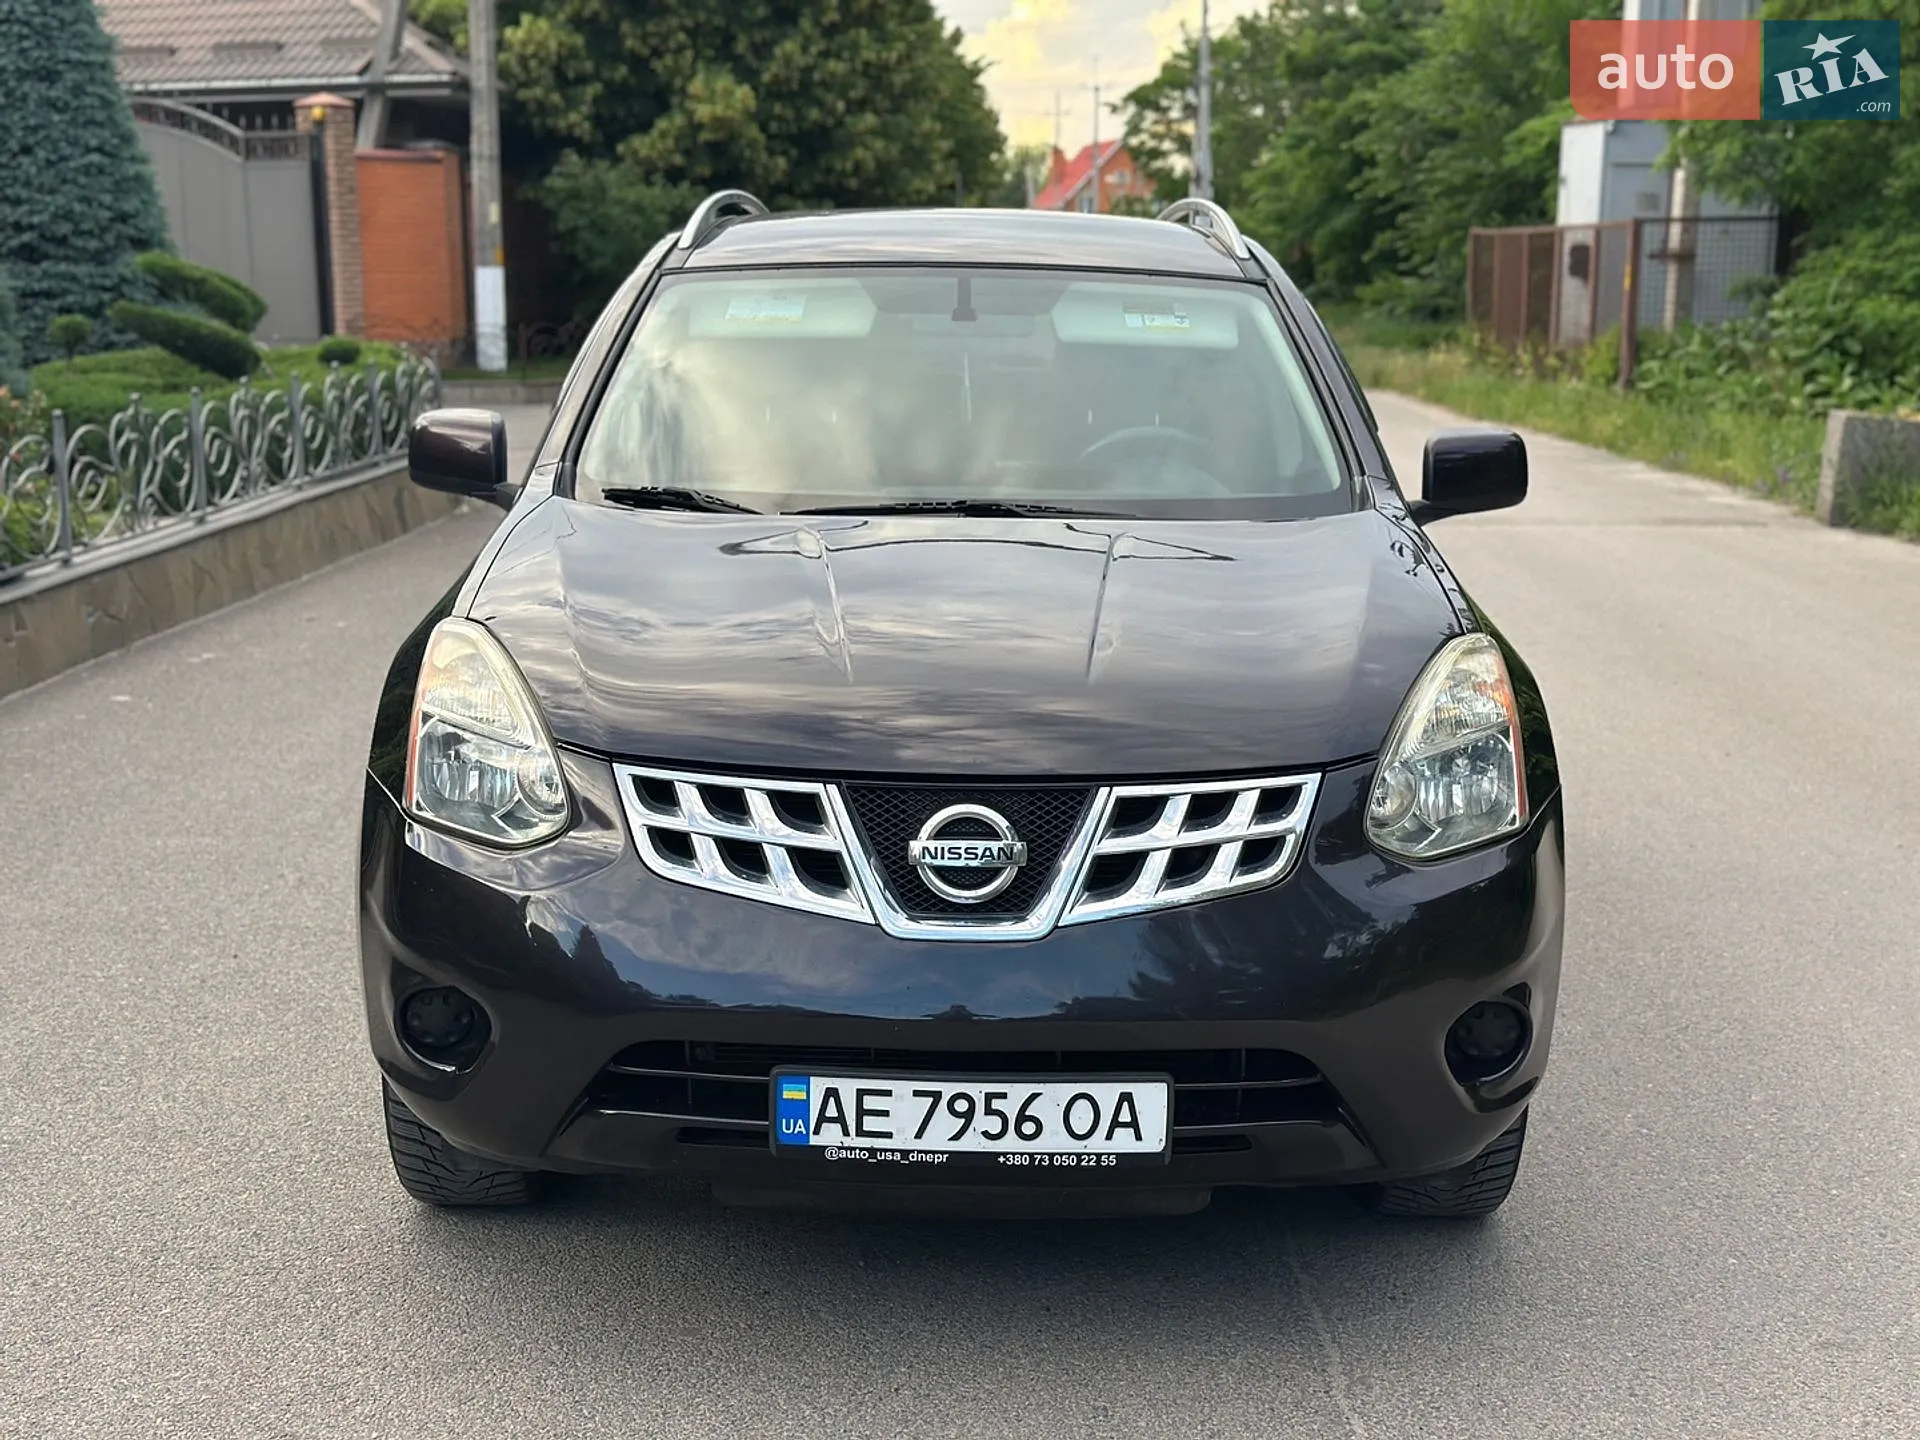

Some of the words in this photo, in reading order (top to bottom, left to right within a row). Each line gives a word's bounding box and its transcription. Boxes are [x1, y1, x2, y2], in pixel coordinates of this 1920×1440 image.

[921, 846, 1014, 861] NISSAN
[812, 1086, 893, 1140] AE
[912, 1089, 1044, 1142] 7956
[1063, 1091, 1143, 1142] OA
[782, 1118, 806, 1135] UA
[824, 1147, 949, 1164] @auto_usa_dnepr
[997, 1154, 1030, 1166] +380
[1034, 1154, 1050, 1166] 73
[1053, 1154, 1078, 1166] 050
[1081, 1154, 1097, 1166] 22
[1100, 1154, 1117, 1166] 55
